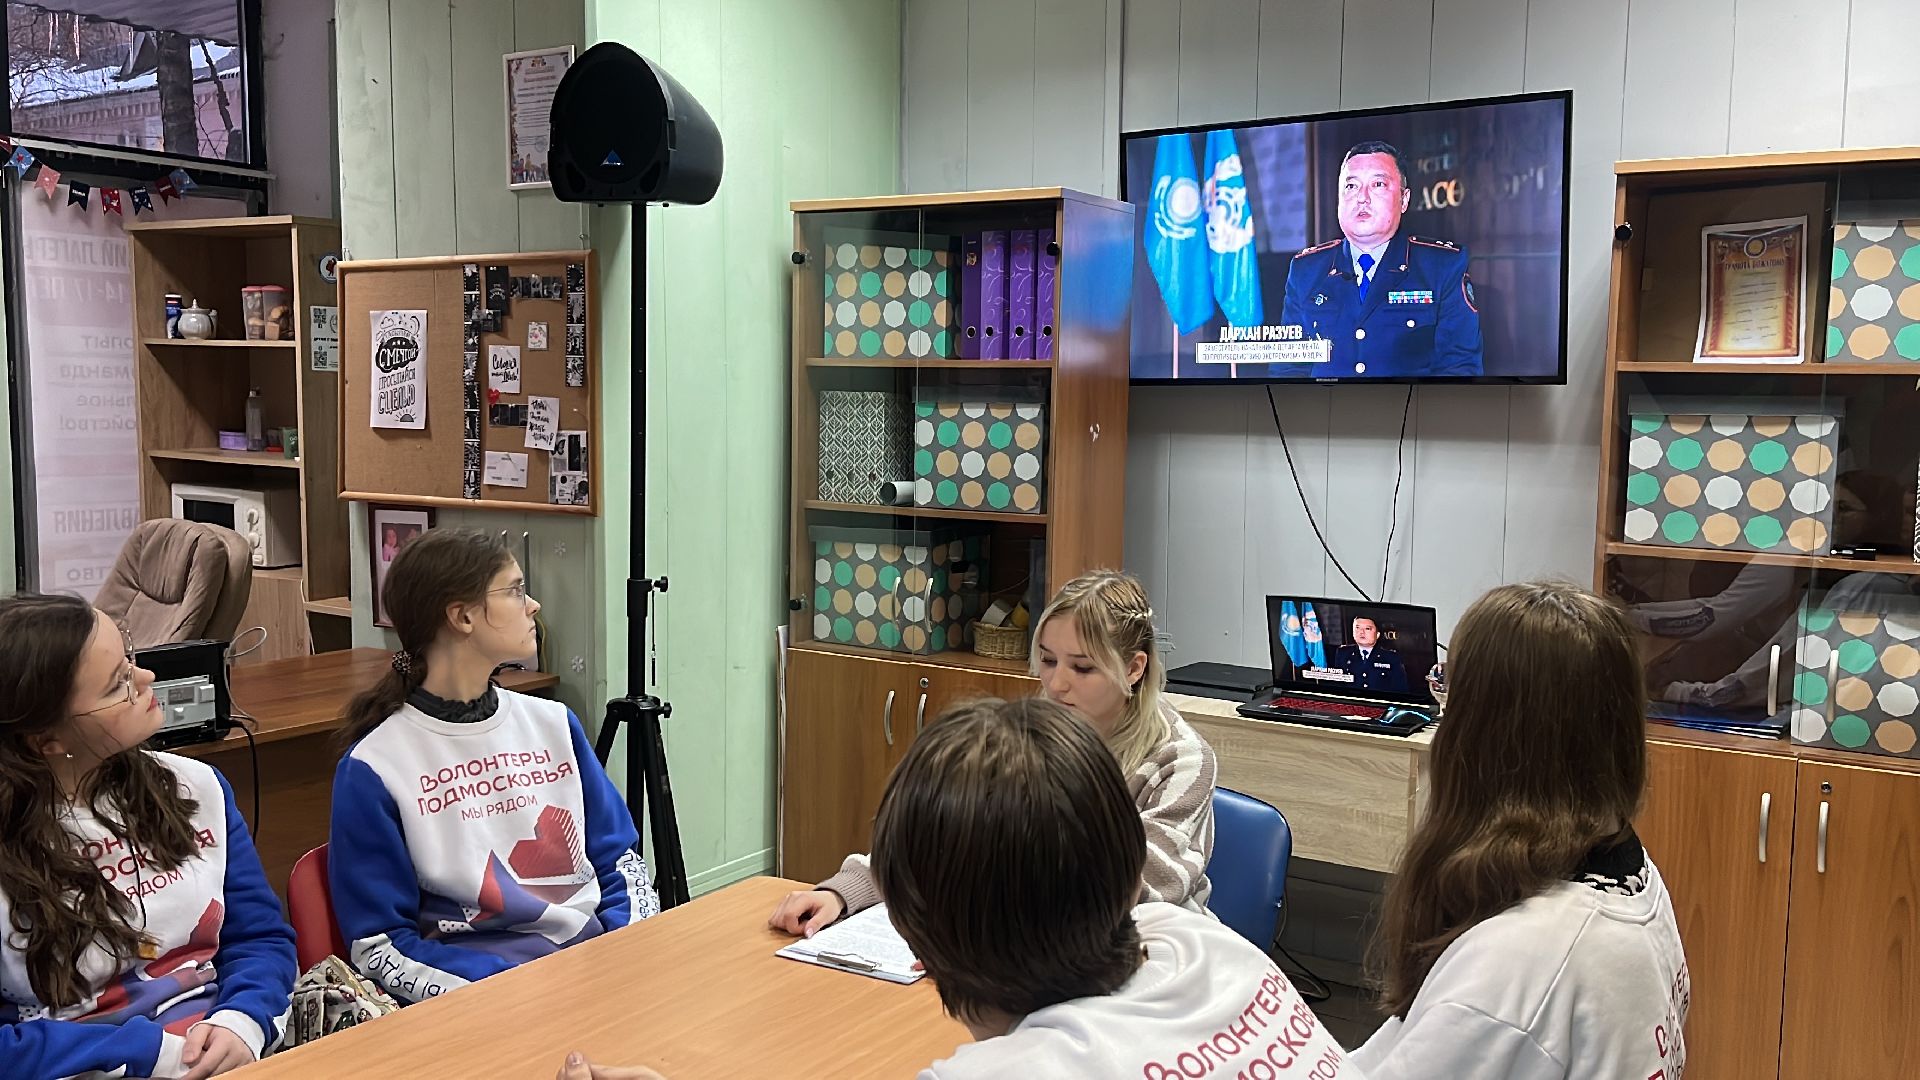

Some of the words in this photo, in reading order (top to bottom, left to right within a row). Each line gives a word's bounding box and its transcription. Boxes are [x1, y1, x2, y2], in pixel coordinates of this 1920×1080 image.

[1220, 326, 1261, 342] ДАРХАН
[1262, 325, 1303, 340] РАЗУЕВ
[420, 750, 551, 793] ВОЛОНТЕРЫ
[417, 762, 573, 816] ПОДМОСКОВЬЯ
[461, 807, 483, 821] МЫ
[486, 795, 538, 817] РЯДОМ
[124, 867, 184, 901] ЯДОМ
